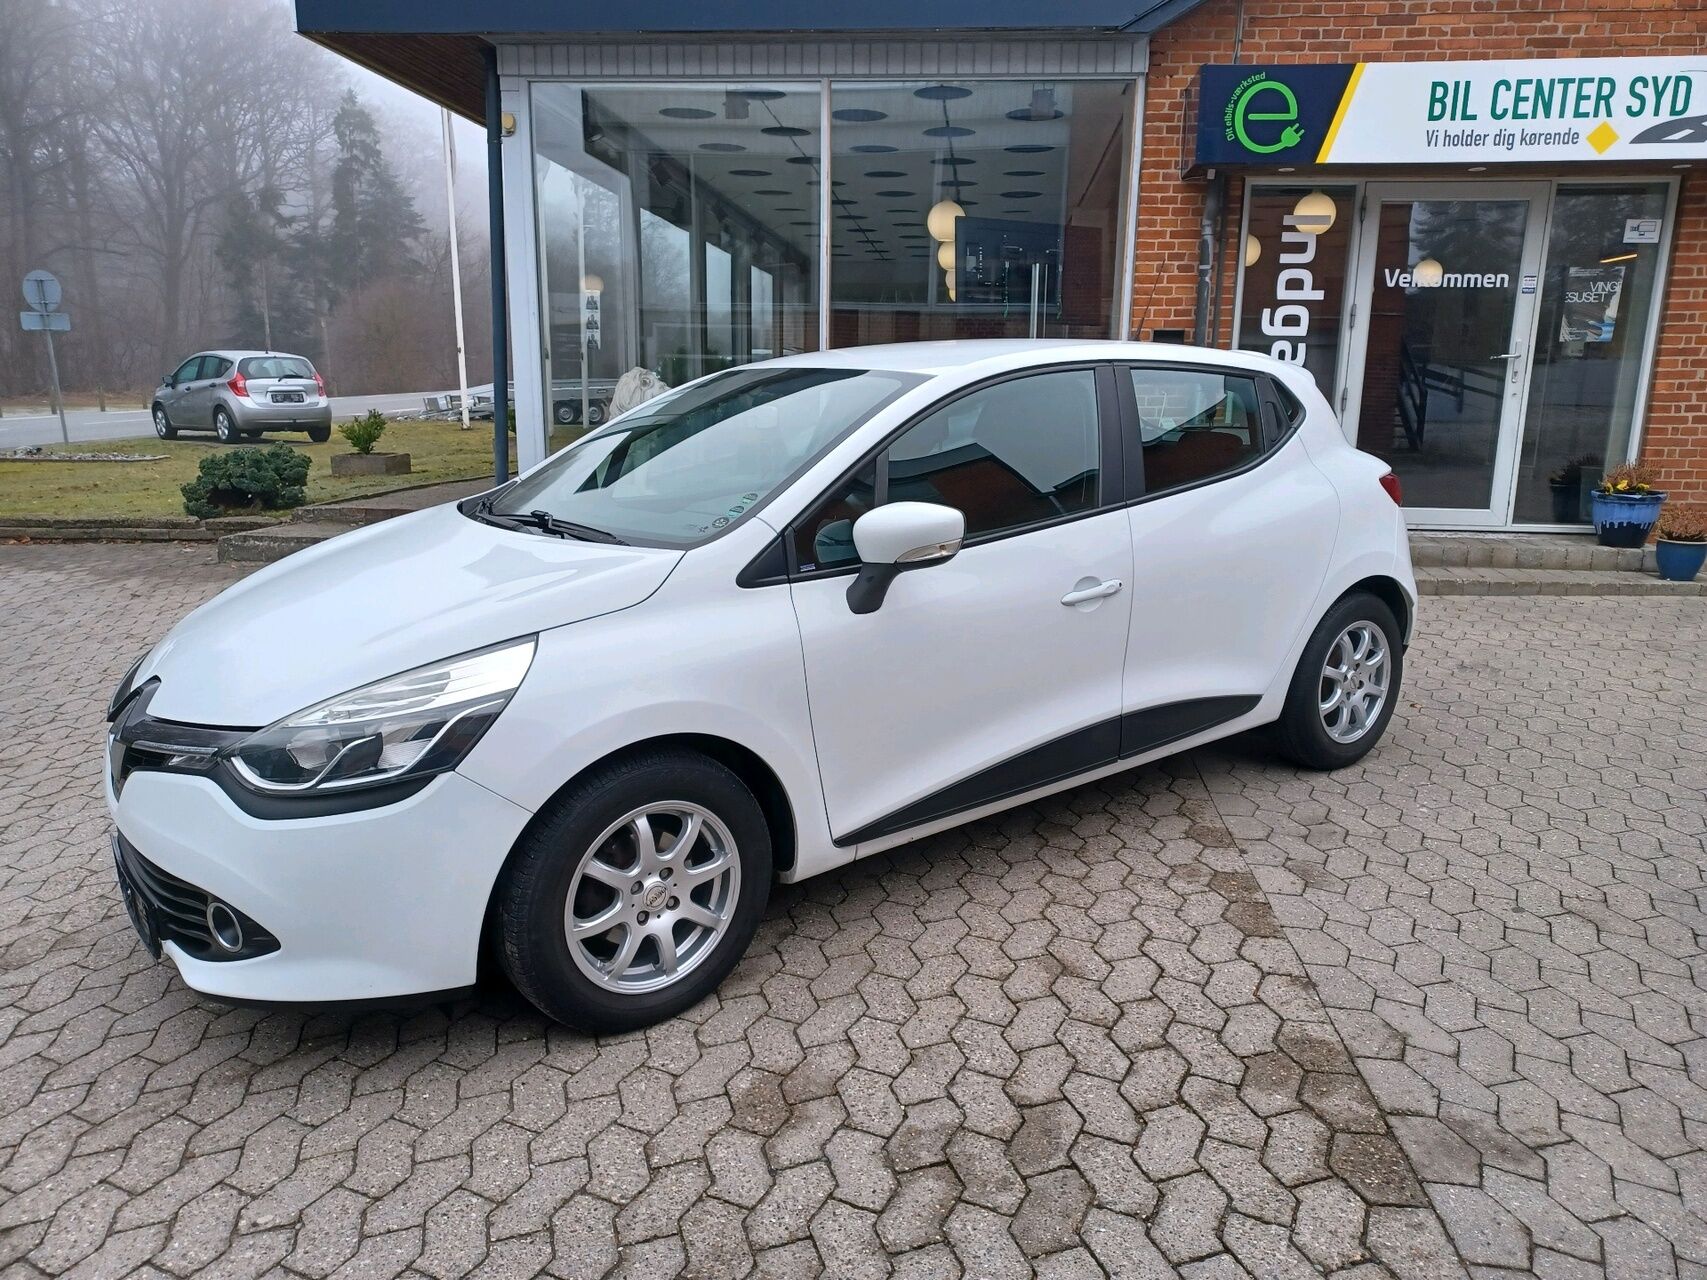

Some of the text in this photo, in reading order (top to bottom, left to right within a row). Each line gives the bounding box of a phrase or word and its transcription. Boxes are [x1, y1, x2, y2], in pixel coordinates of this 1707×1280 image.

[1427, 75, 1693, 122] BIL CENTER SYD
[1225, 127, 1235, 141] Dit
[1426, 127, 1580, 151] Vi holder dig kørende
[1383, 268, 1510, 288] Velommen
